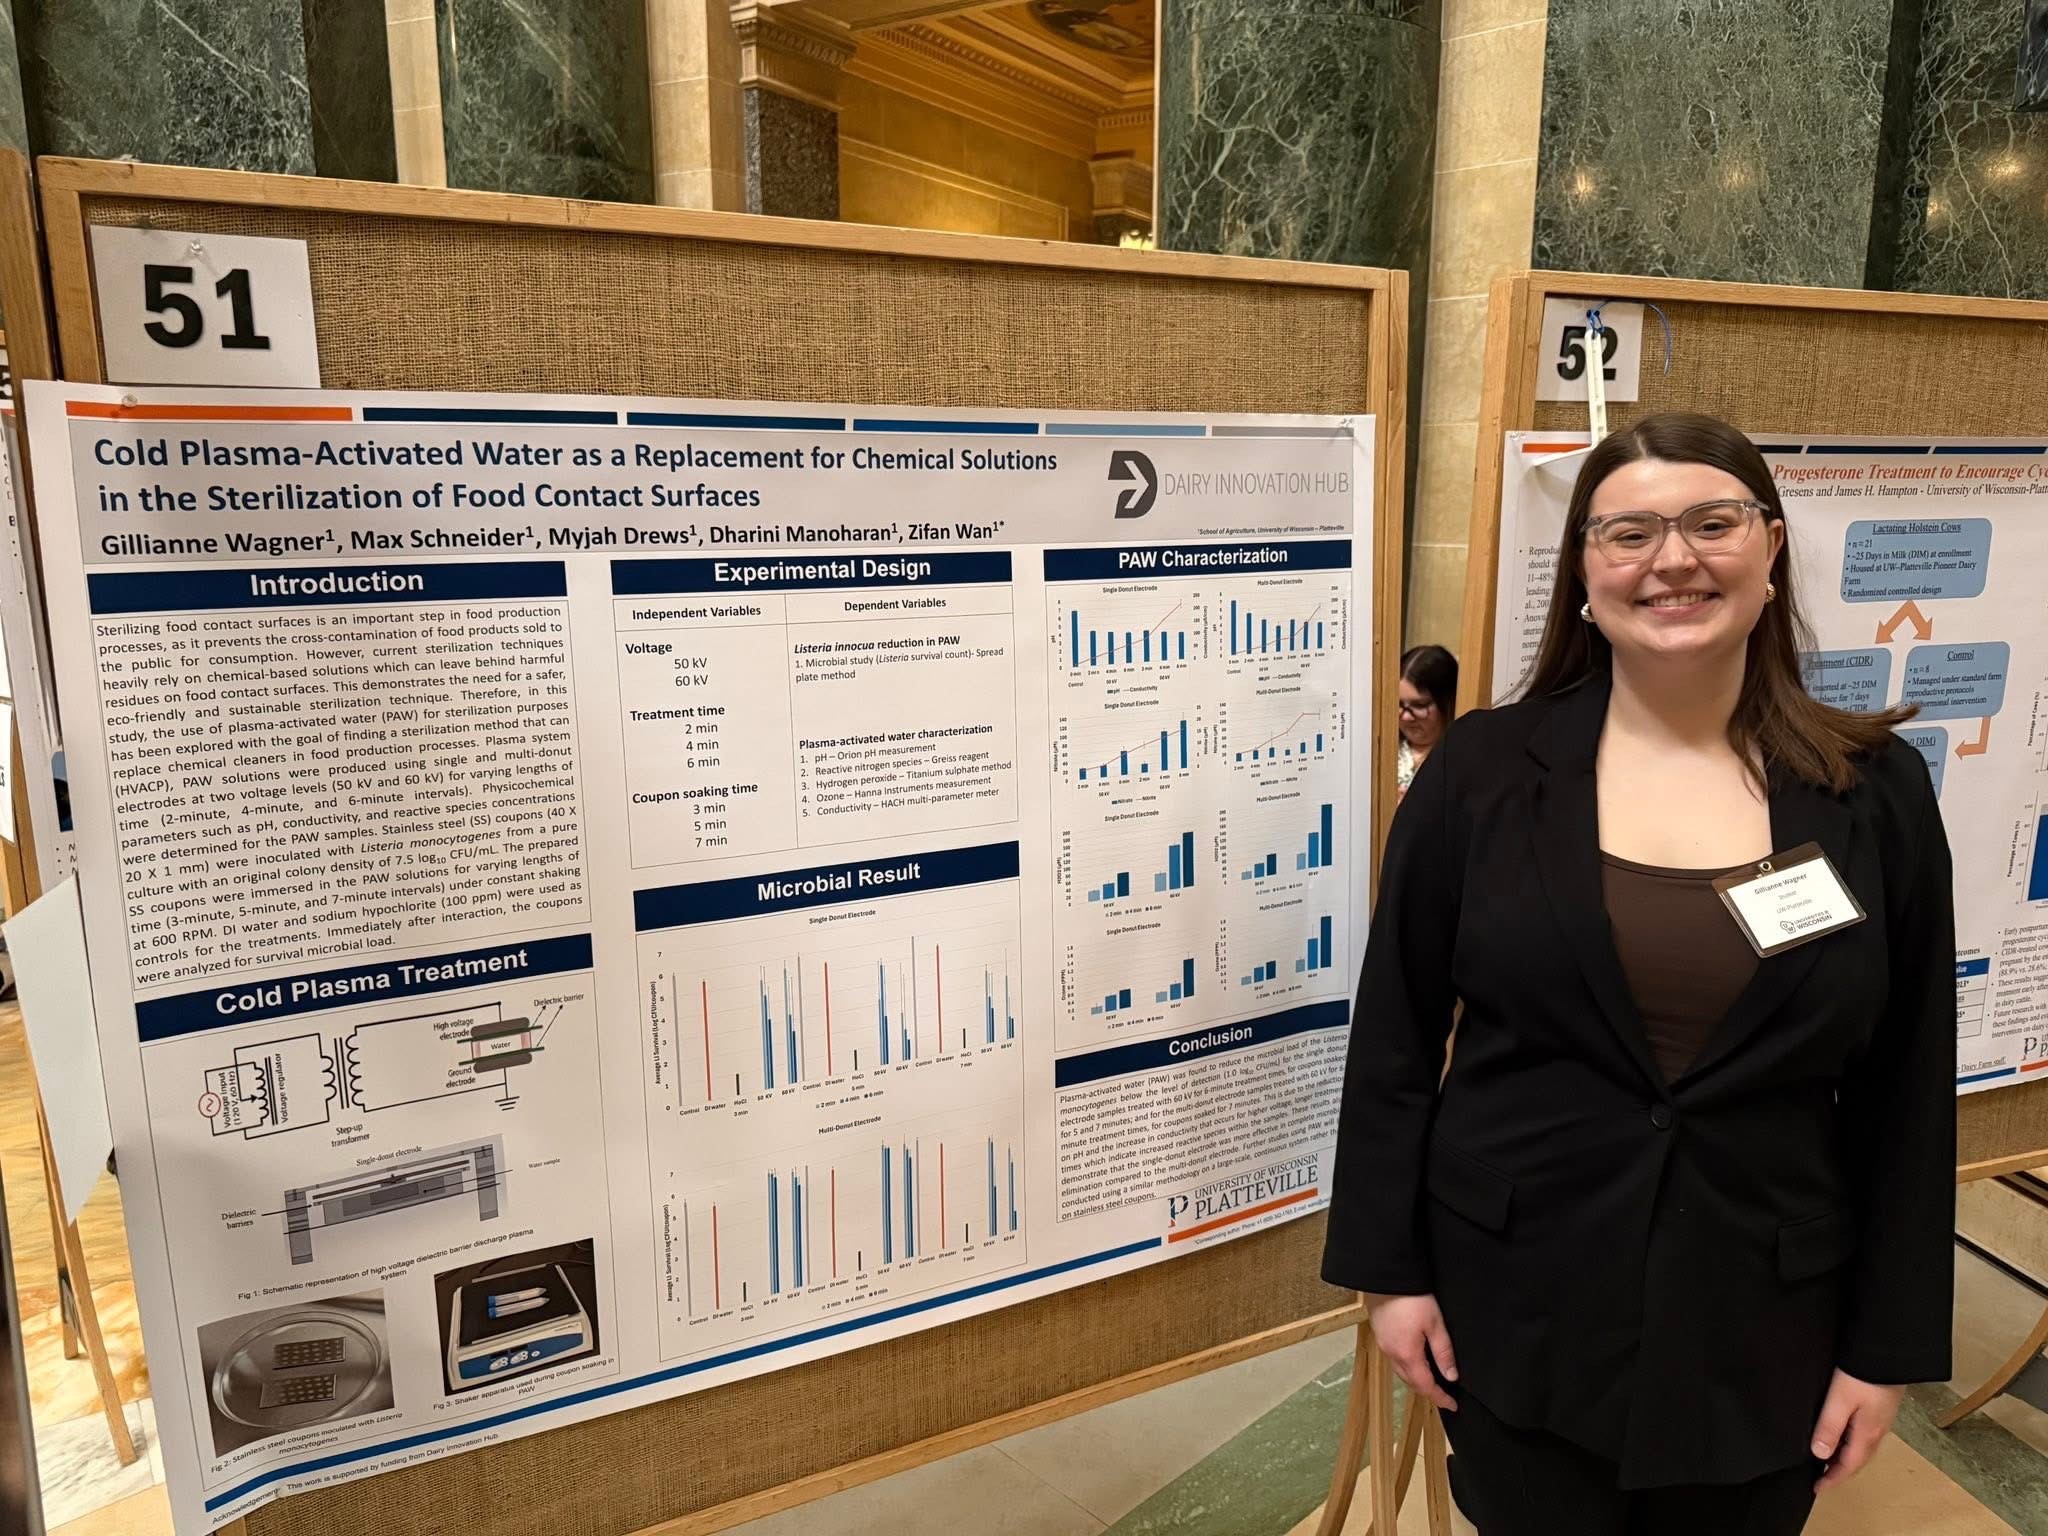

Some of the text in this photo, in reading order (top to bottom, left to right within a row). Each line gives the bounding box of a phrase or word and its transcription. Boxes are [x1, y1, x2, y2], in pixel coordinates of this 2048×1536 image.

[143, 264, 270, 350] 51
[1557, 326, 1618, 381] 52
[95, 438, 1057, 473] Cold Plasma-Activated Water as a Replacement for Chemical Solutions
[1774, 464, 1864, 482] Progesterone
[1869, 464, 1937, 479] Treatment
[1939, 466, 1953, 479] to
[1956, 464, 2025, 482] Encourage
[1165, 472, 1349, 495] DAIRY INNOVATION HUB
[1816, 485, 1833, 498] and
[1834, 485, 1863, 498] James
[1864, 485, 1874, 496] H.
[1878, 484, 1918, 498] Hampton
[1927, 483, 1971, 496] University
[1972, 484, 1985, 495] of
[99, 482, 760, 512] in the Sterilization of Food Contact Surfaces
[101, 534, 218, 555] Gillianne
[351, 530, 404, 549] Max
[549, 526, 616, 549] Myjah
[710, 525, 780, 543] Dharini
[908, 523, 950, 540] Zifan
[1119, 547, 1288, 569] PAW Characterization
[714, 558, 931, 586] Experimental Design
[251, 571, 423, 596] Introduction
[632, 605, 761, 621] Independent Variables
[845, 598, 946, 613] Dependent Variables
[97, 607, 560, 636] Sterilizing food contact surfaces is an important step in food production
[625, 642, 672, 655] Voltage
[794, 636, 960, 654] Listeria innocua reduction in PAW
[674, 657, 707, 670] 50 kV
[1946, 649, 1974, 662] Control
[675, 675, 708, 687] 60 kV
[629, 705, 725, 721] Treatment time
[685, 722, 718, 735] 2 min
[799, 724, 993, 749] Plasma-activated water characterization
[632, 784, 758, 804] Coupon soaking time
[694, 802, 726, 815] 3 min
[758, 863, 921, 901] Microbial Result
[809, 910, 876, 925] Single Donut Electrode
[1797, 914, 1833, 929] WISCONSIN
[216, 949, 528, 1014] Cold Plasma Treatment
[433, 1018, 473, 1031] High voltage
[439, 1029, 470, 1041] electrode
[1169, 1027, 1252, 1056] Conclusion
[491, 1042, 511, 1050] Water
[448, 1066, 472, 1077] Ground
[275, 1053, 288, 1123] Voltage regulator
[336, 1124, 363, 1136] Step-up
[331, 1133, 370, 1147] transformer
[1195, 1153, 1318, 1199] UNIVERSITY OF WISCONSIN
[1195, 1165, 1318, 1220] PLATTEVILLE
[263, 1283, 304, 1295] Schematic
[305, 1272, 360, 1288] representation
[361, 1269, 369, 1277] of
[370, 1266, 387, 1275] high
[388, 1259, 415, 1270] voltage
[416, 1250, 448, 1263] dielectric
[449, 1243, 472, 1254] barrier
[473, 1235, 507, 1247] discharge
[508, 1229, 533, 1240] plasma
[304, 1478, 322, 1486] work
[332, 1466, 369, 1480] supported
[380, 1457, 407, 1467] funding
[408, 1452, 425, 1461] from
[426, 1448, 445, 1456] Dairy
[446, 1438, 482, 1451] Innovation
